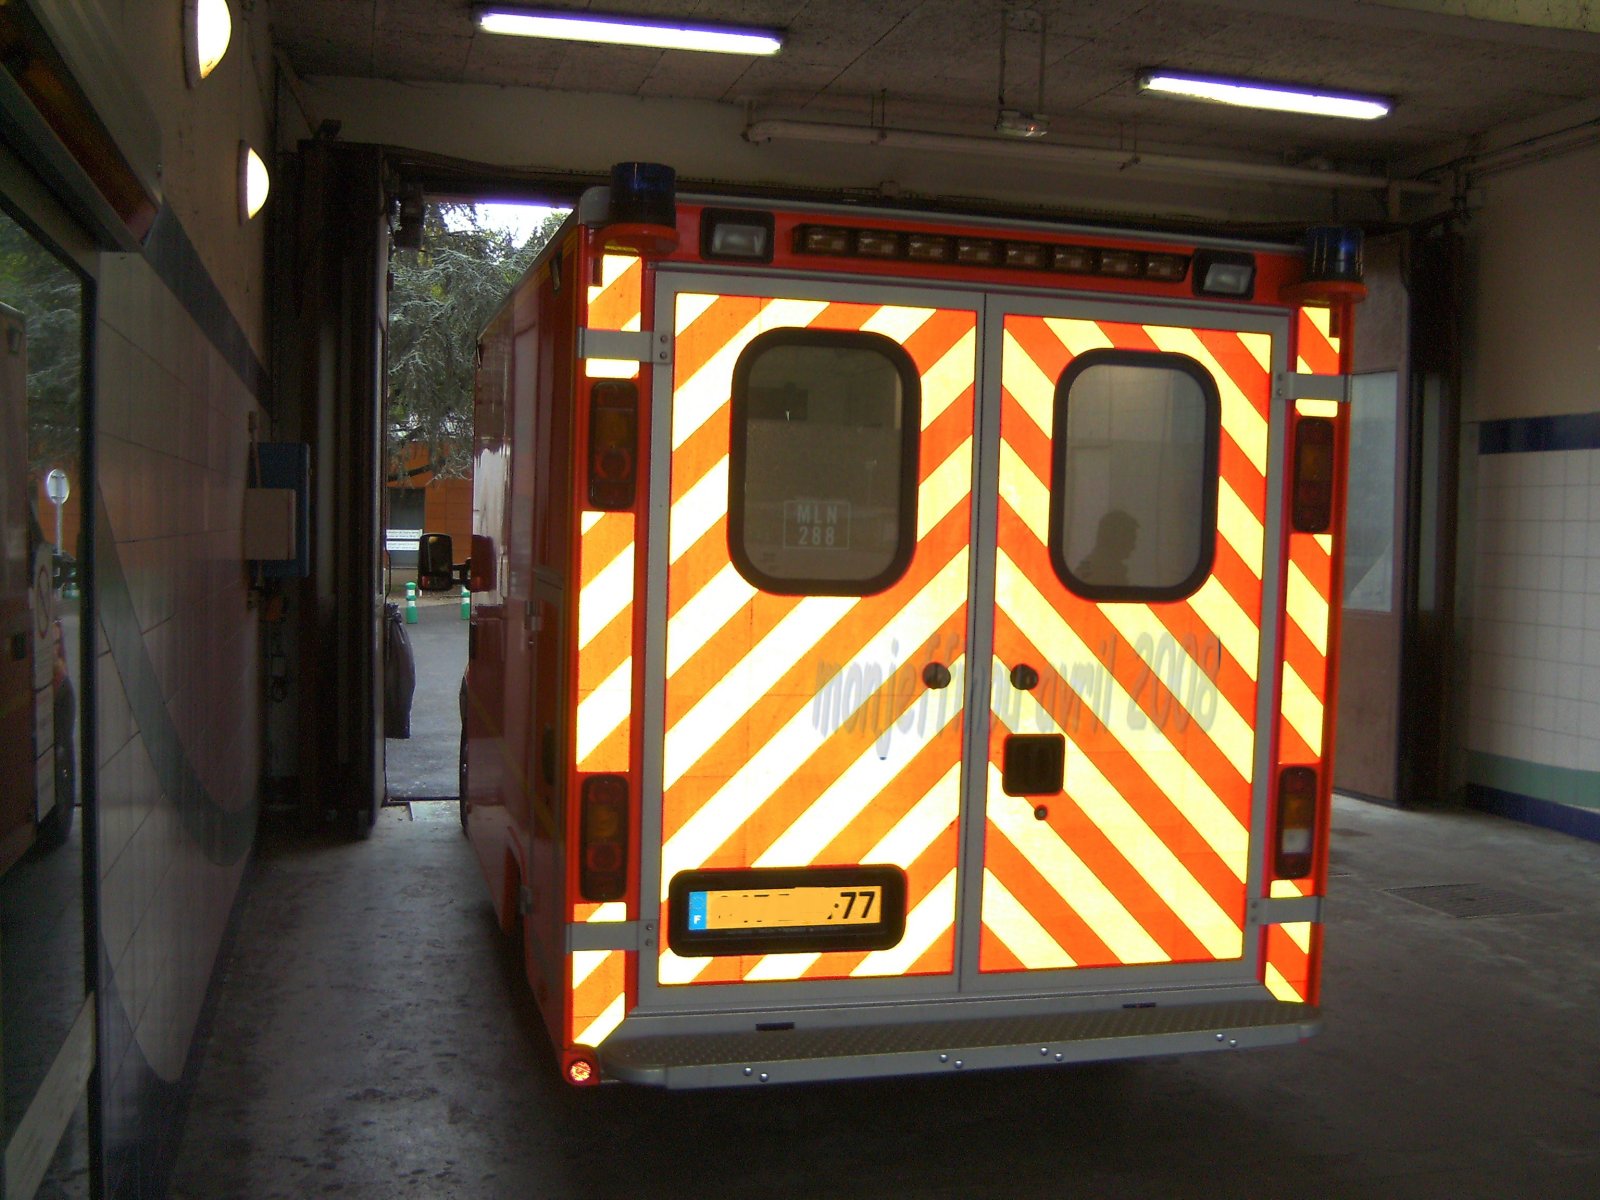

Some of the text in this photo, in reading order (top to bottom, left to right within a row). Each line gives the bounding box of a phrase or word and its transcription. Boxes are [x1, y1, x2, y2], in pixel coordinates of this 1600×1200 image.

[797, 504, 838, 524] MLN
[798, 526, 835, 547] 288
[840, 891, 876, 920] 77
[693, 914, 701, 924] F
